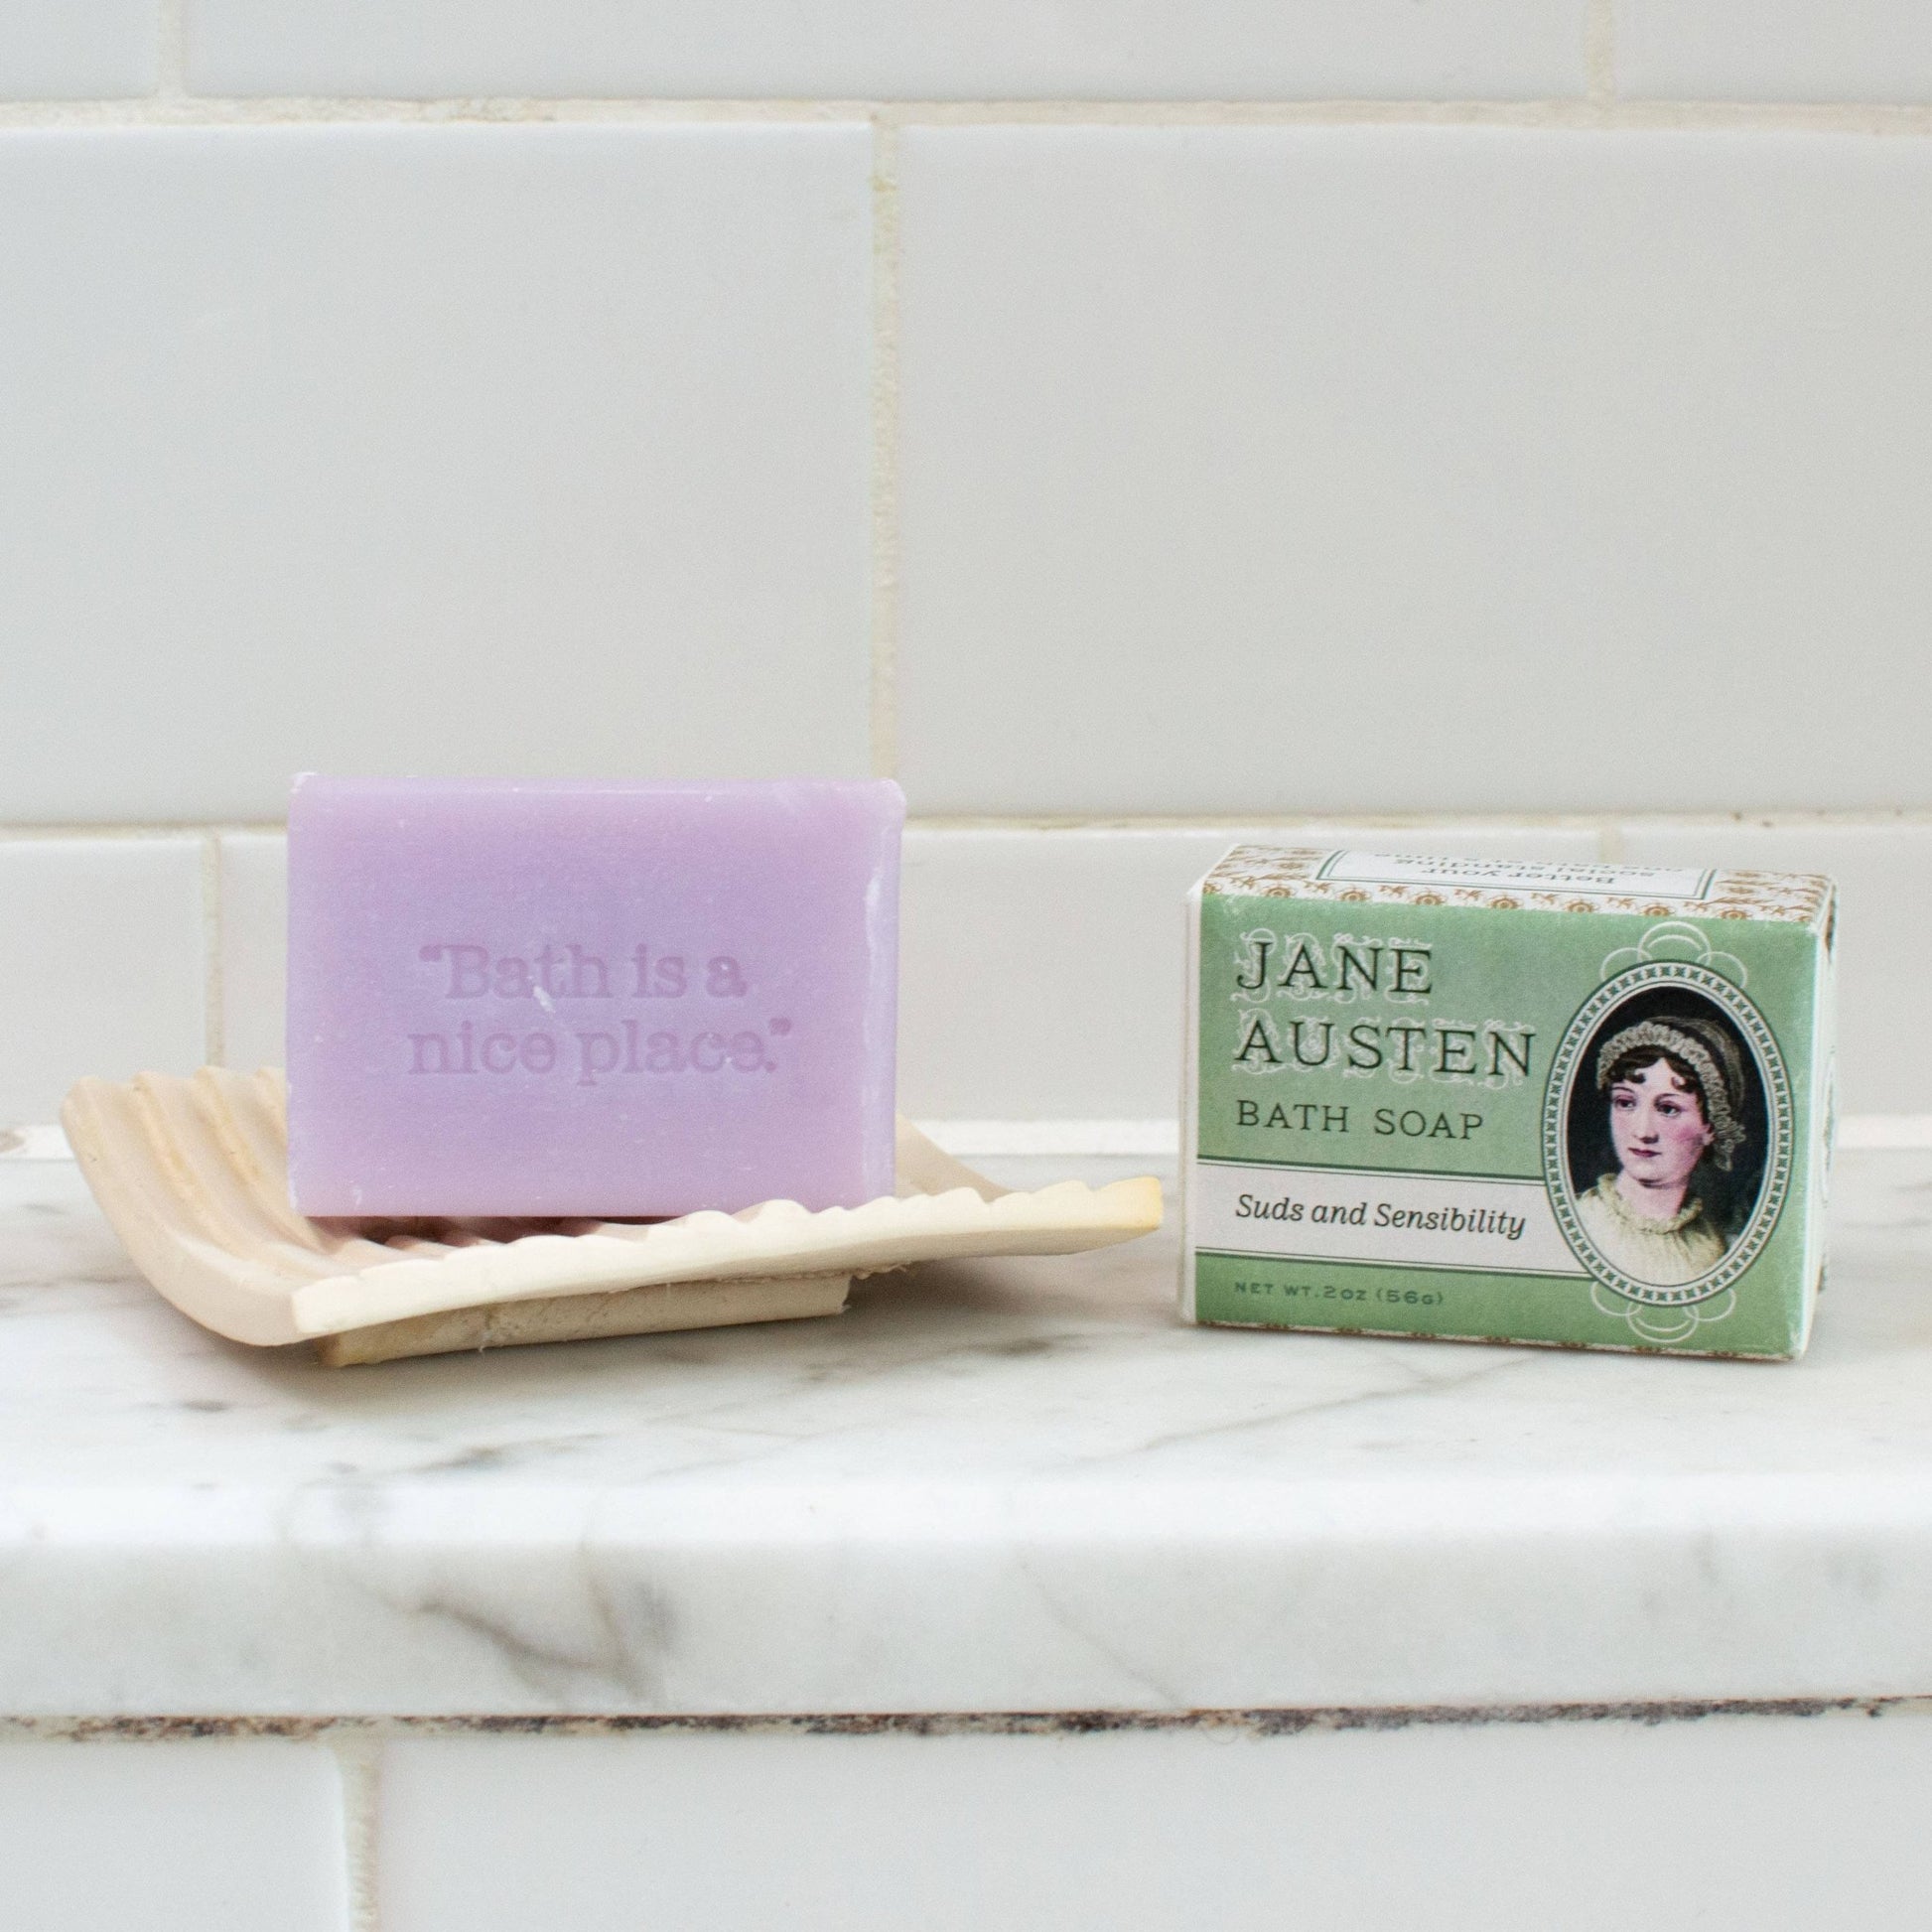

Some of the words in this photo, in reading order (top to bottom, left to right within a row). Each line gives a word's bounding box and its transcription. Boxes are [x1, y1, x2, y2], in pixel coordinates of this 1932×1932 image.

[631, 942, 688, 1000] is
[705, 955, 749, 999] a
[1235, 940, 1434, 995] JANE
[407, 1020, 557, 1076] nice
[1234, 1019, 1537, 1077] AUSTEN
[1236, 1099, 1349, 1134] BATH
[1373, 1108, 1484, 1142] SOAP
[1235, 1193, 1304, 1222] Suds
[1311, 1202, 1368, 1226] and
[1373, 1202, 1527, 1241] Sensibility
[1233, 1281, 1275, 1296] NET
